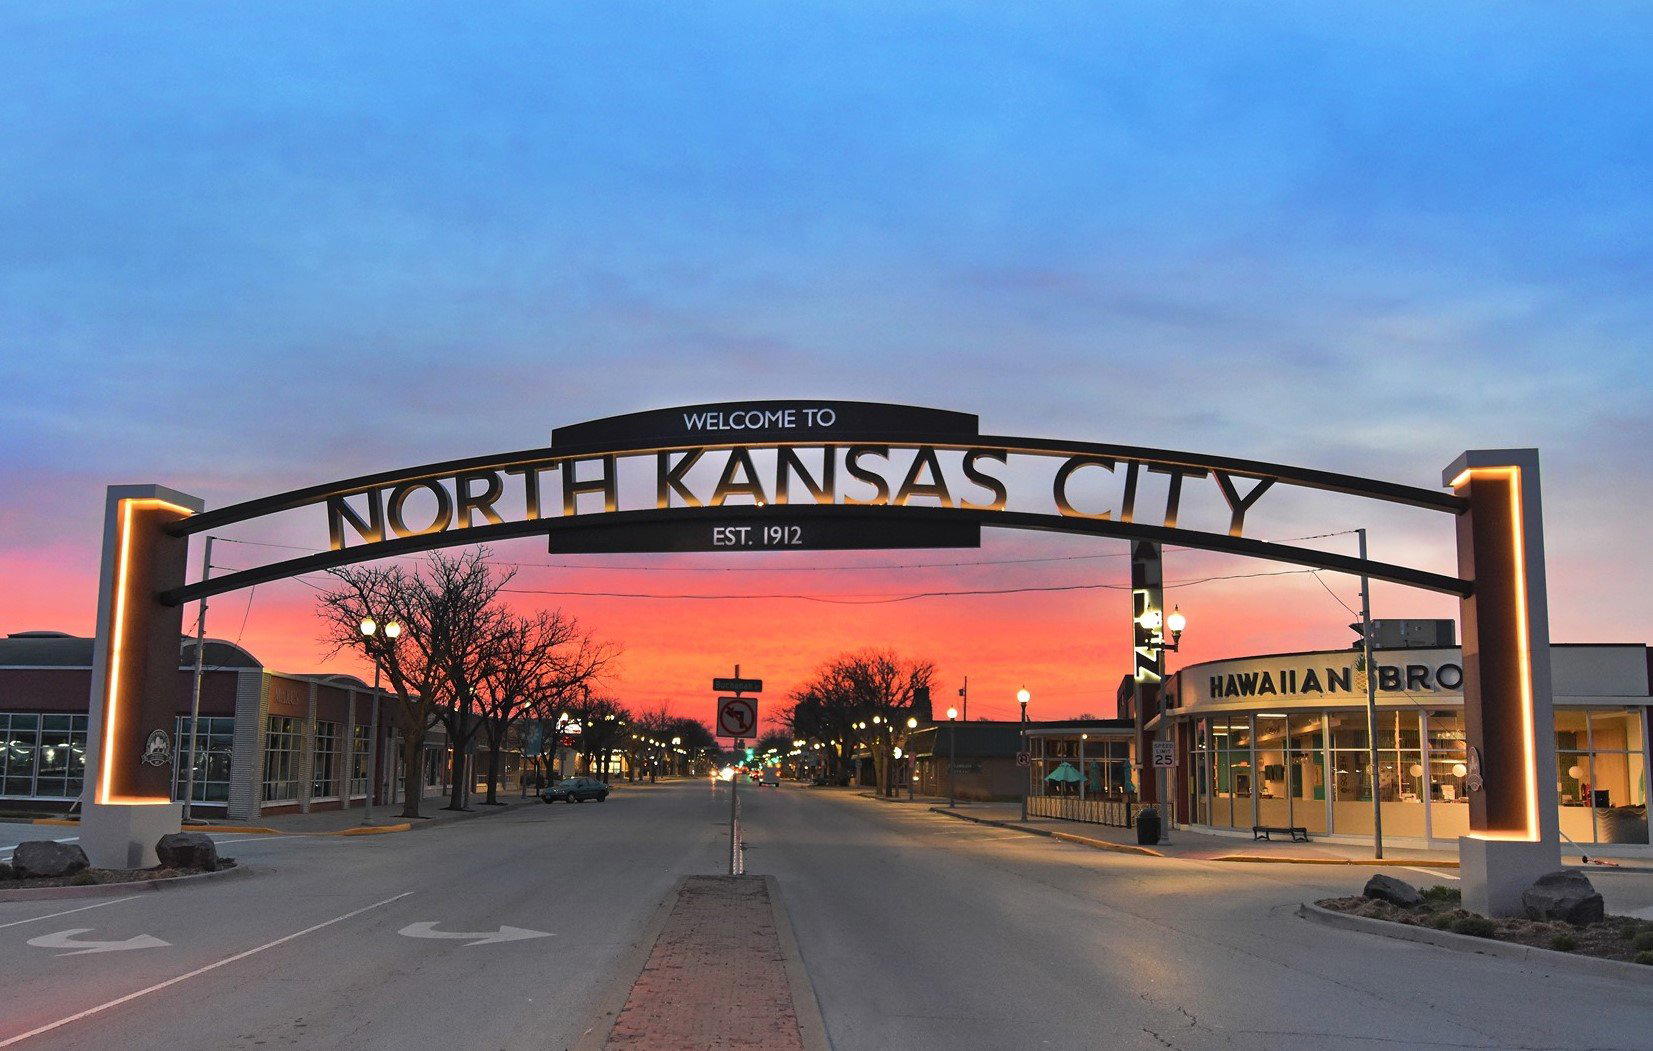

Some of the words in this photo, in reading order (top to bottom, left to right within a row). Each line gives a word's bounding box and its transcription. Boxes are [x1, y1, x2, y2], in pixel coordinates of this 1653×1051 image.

[683, 410, 796, 431] WELCOME
[802, 408, 836, 427] TO
[327, 453, 618, 550] NORTH
[656, 444, 1008, 511] KANSAS
[1053, 455, 1277, 538] CITY
[713, 527, 752, 546] EST.
[762, 526, 802, 545] 1912
[1210, 666, 1352, 699] HAWAIIAN
[1155, 754, 1173, 765] 25
